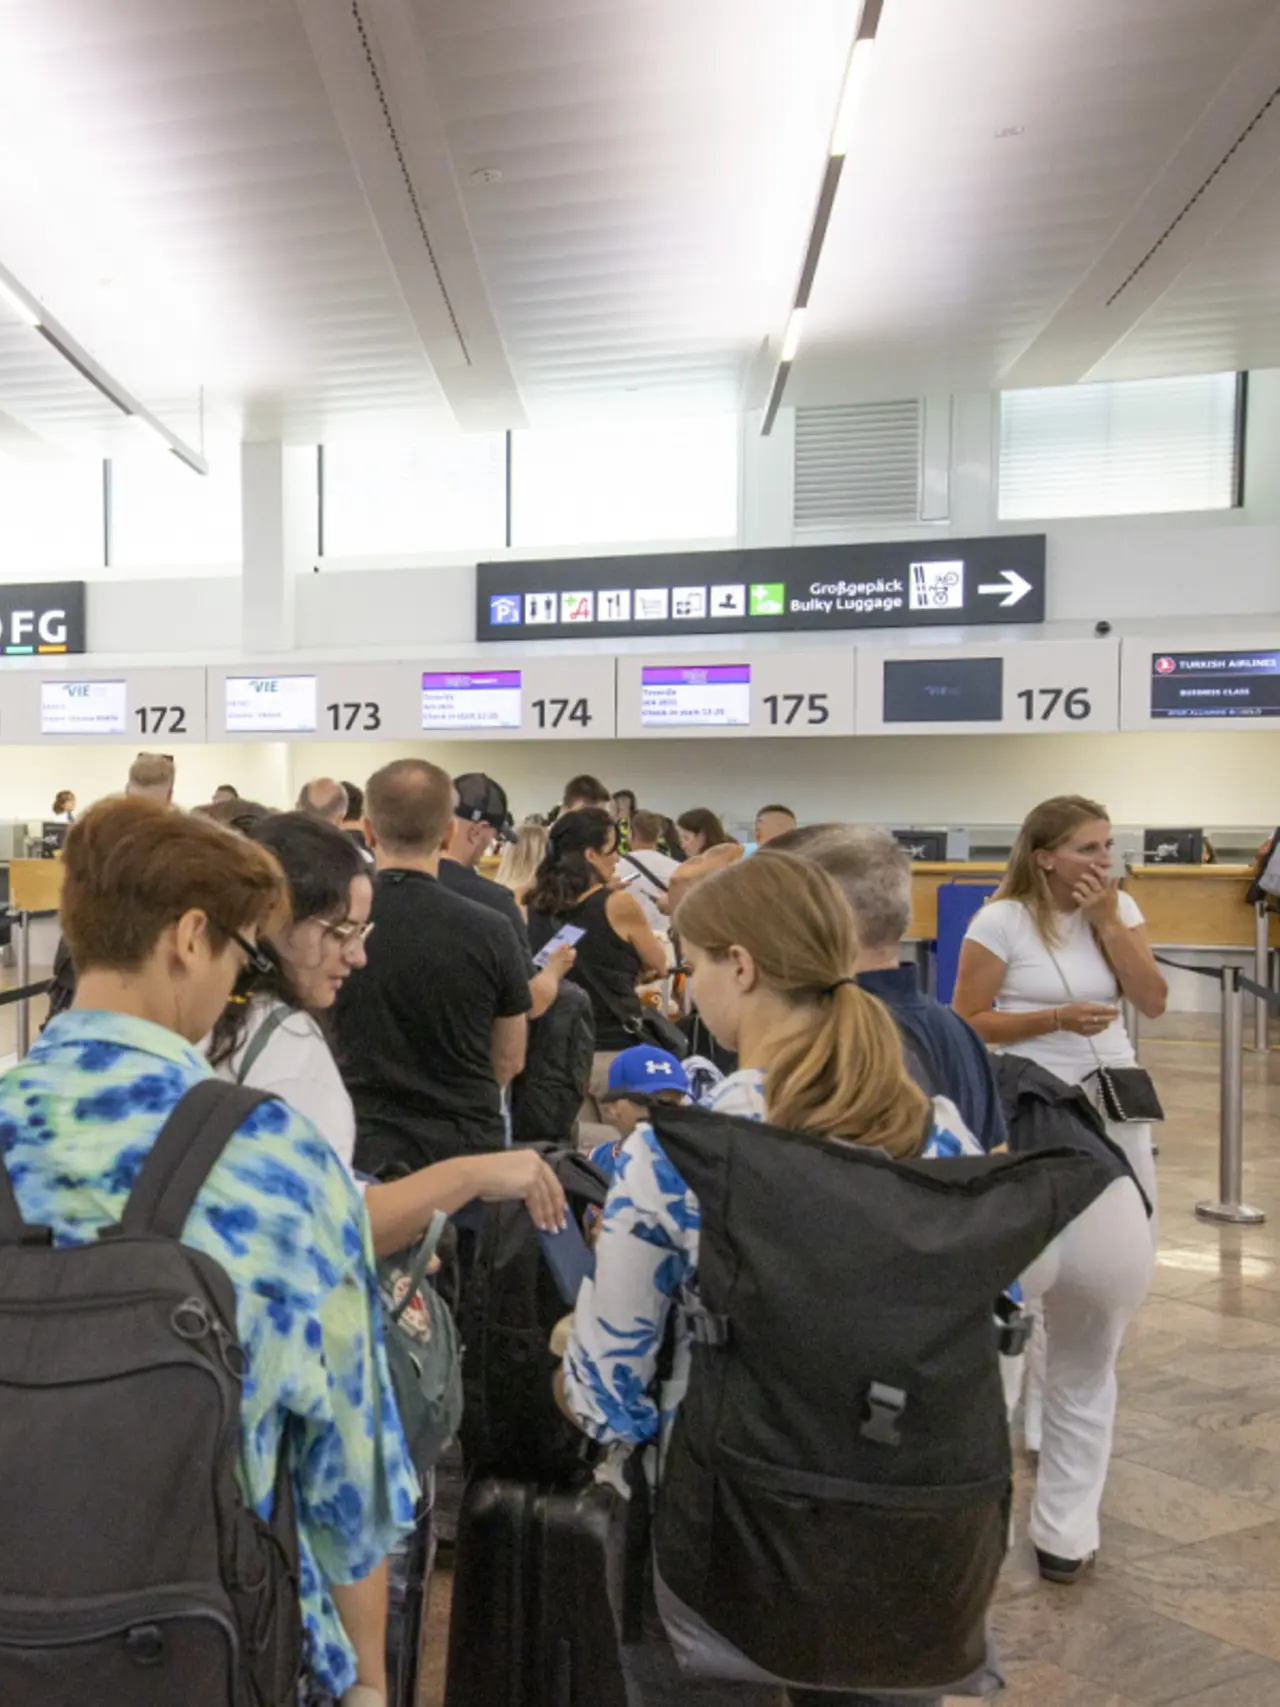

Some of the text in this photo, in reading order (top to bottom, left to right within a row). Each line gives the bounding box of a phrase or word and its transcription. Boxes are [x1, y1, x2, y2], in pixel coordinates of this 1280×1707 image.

[809, 578, 903, 595] Großgepäck
[790, 596, 903, 613] Bulky Luggage
[1179, 658, 1277, 670] TURKISH AIRLINES
[1017, 688, 1092, 720] 176
[1222, 687, 1250, 696] CLASS
[135, 706, 187, 734] 172
[326, 702, 381, 731] 173
[531, 698, 593, 728] 174
[763, 693, 829, 725] 175
